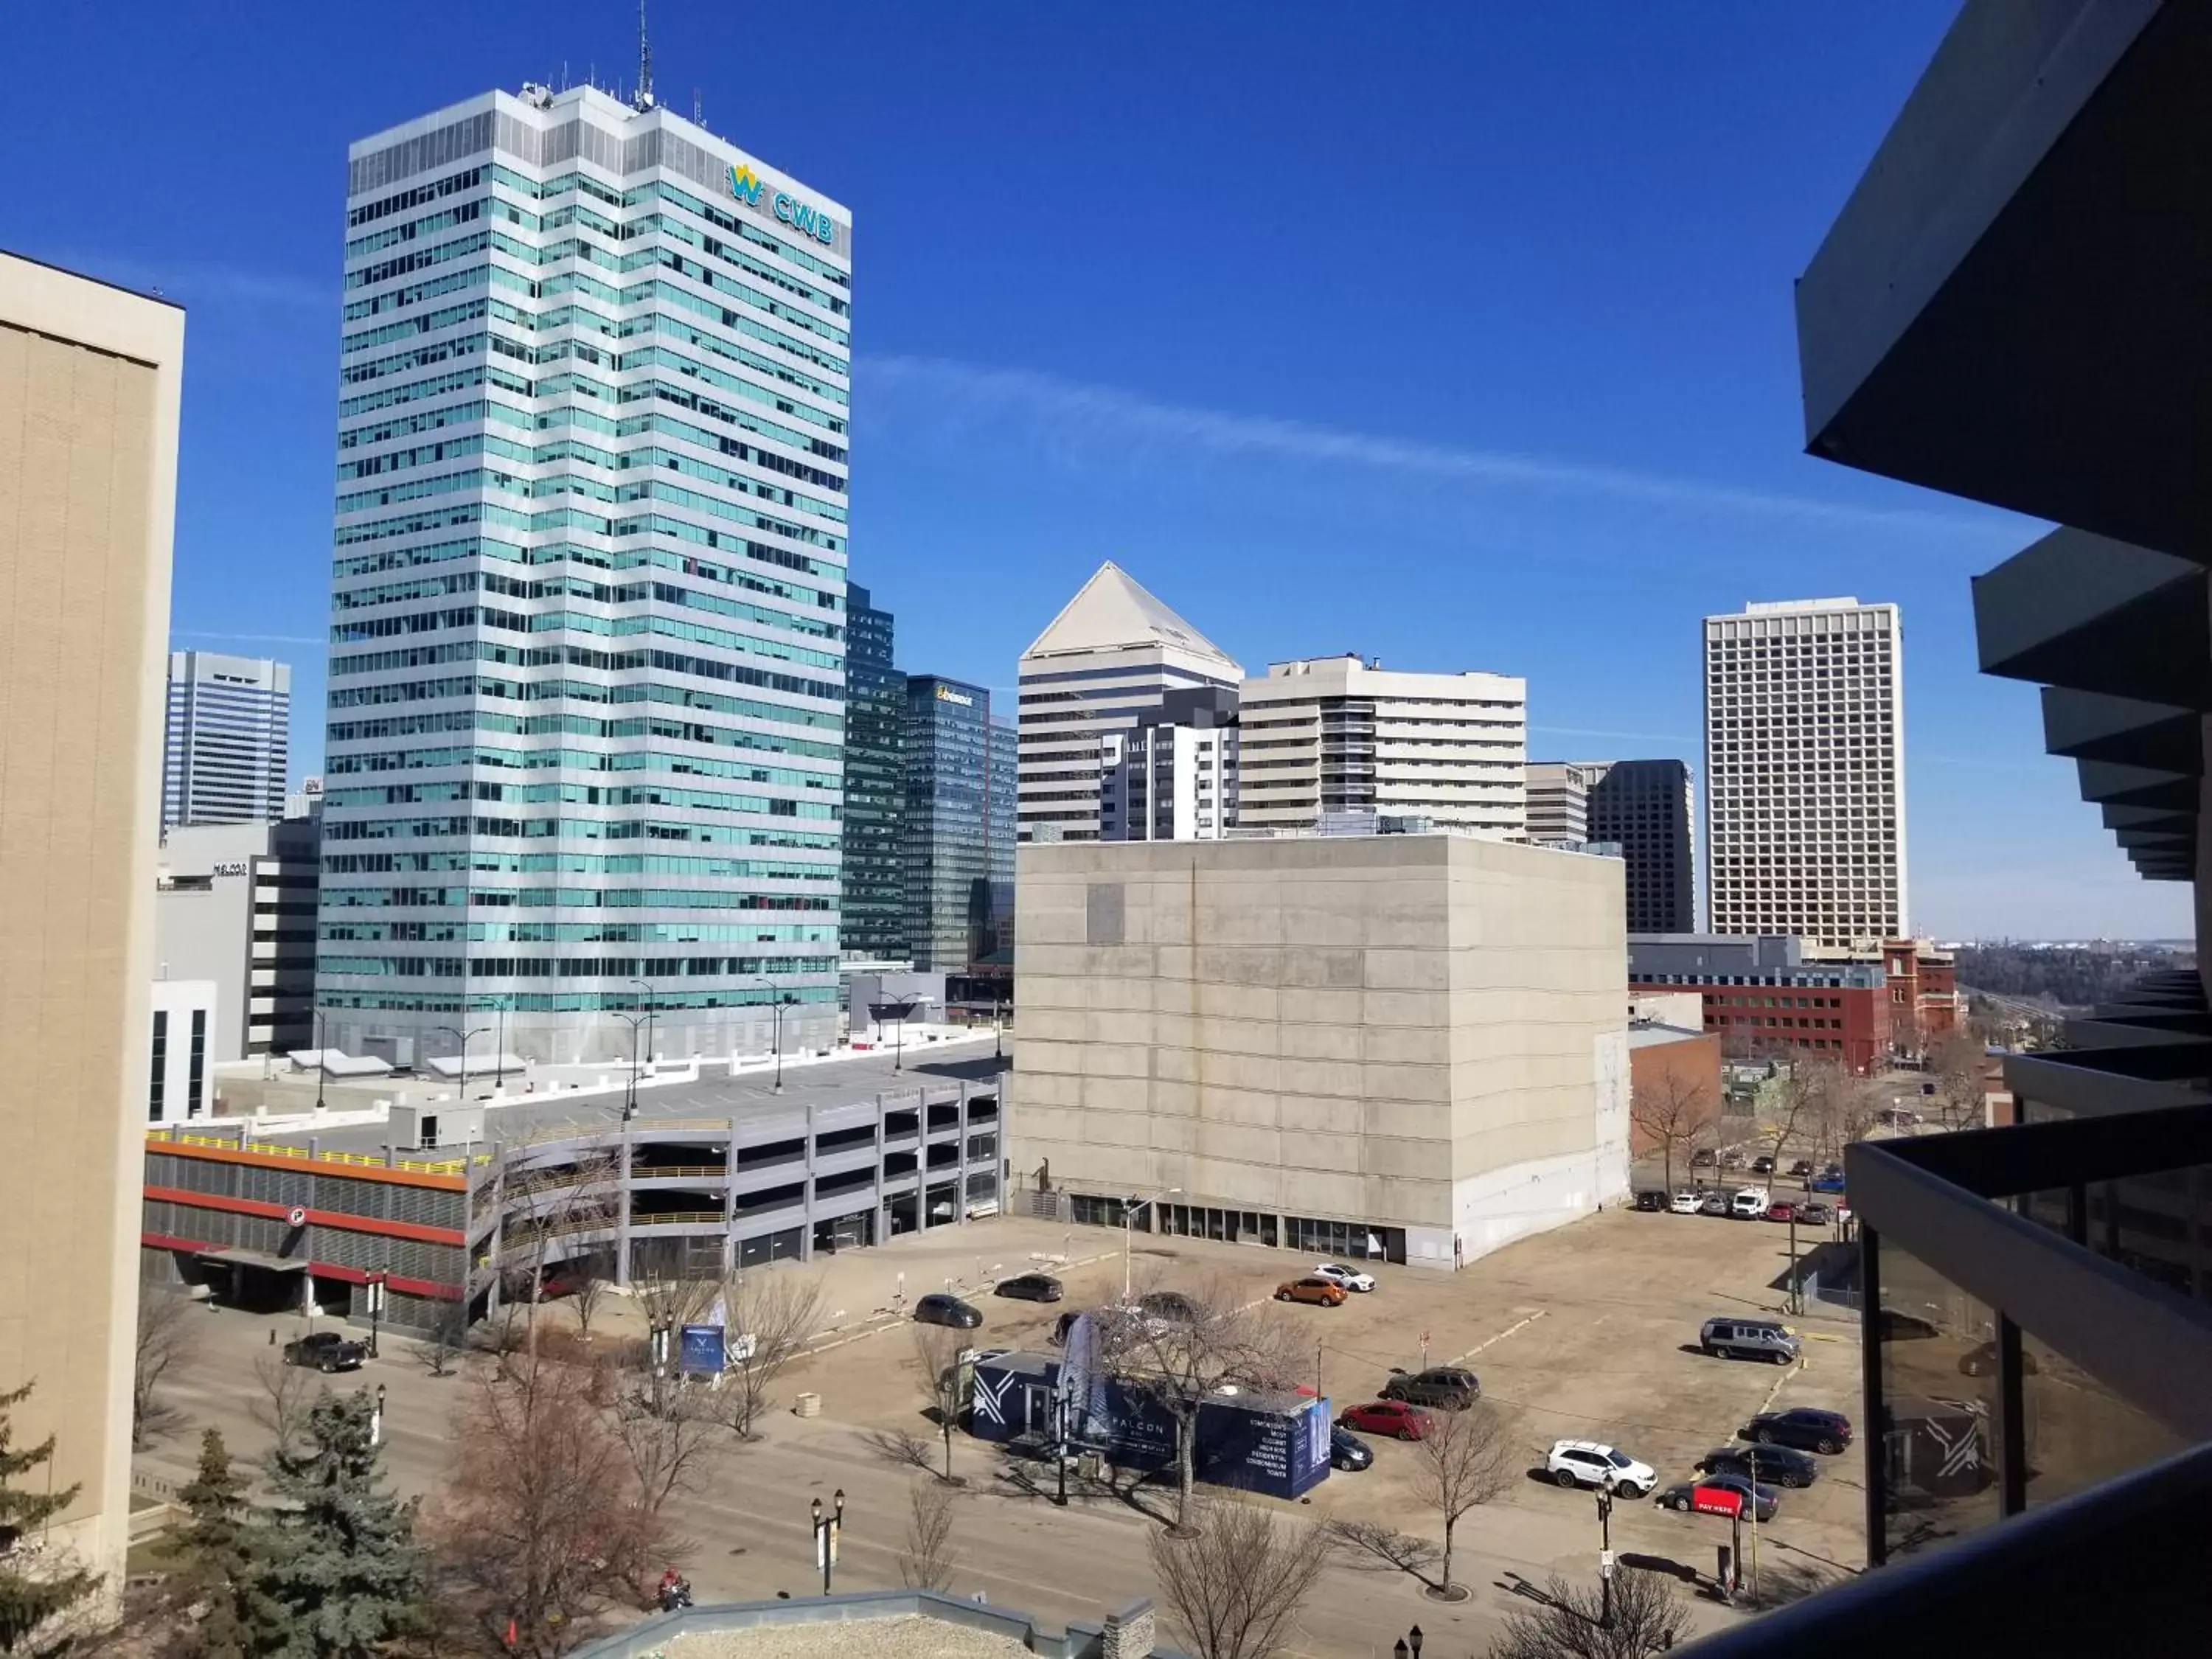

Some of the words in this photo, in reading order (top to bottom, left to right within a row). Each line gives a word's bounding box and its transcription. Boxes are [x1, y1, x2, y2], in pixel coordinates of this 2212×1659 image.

[773, 190, 833, 244] CWB
[1113, 1416, 1164, 1435] FALCON
[1699, 1503, 1713, 1511] PAY
[1713, 1506, 1733, 1514] HERE
